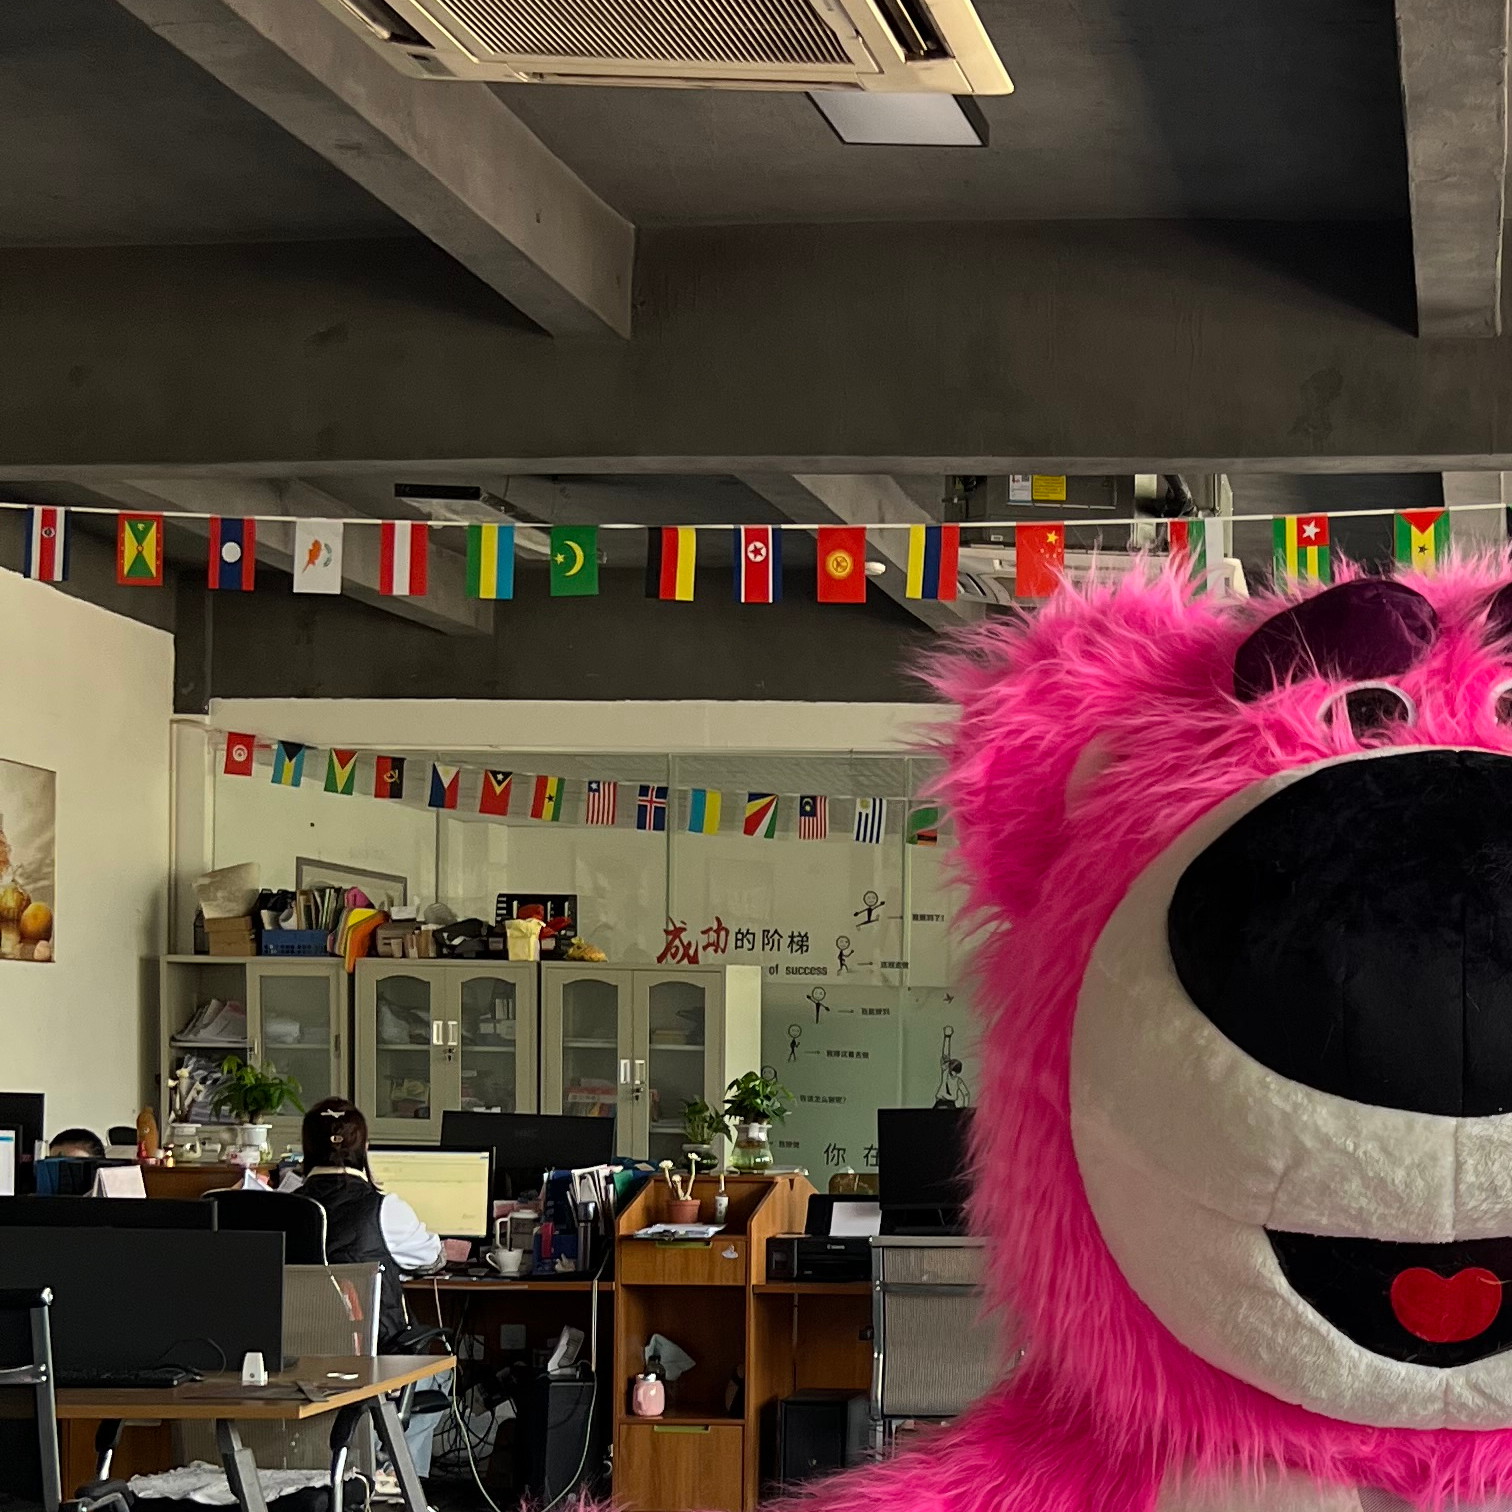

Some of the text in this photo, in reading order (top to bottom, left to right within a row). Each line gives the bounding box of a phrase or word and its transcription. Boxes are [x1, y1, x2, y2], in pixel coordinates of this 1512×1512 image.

[656, 915, 810, 964] 成功的阶梯
[768, 964, 828, 976] of success
